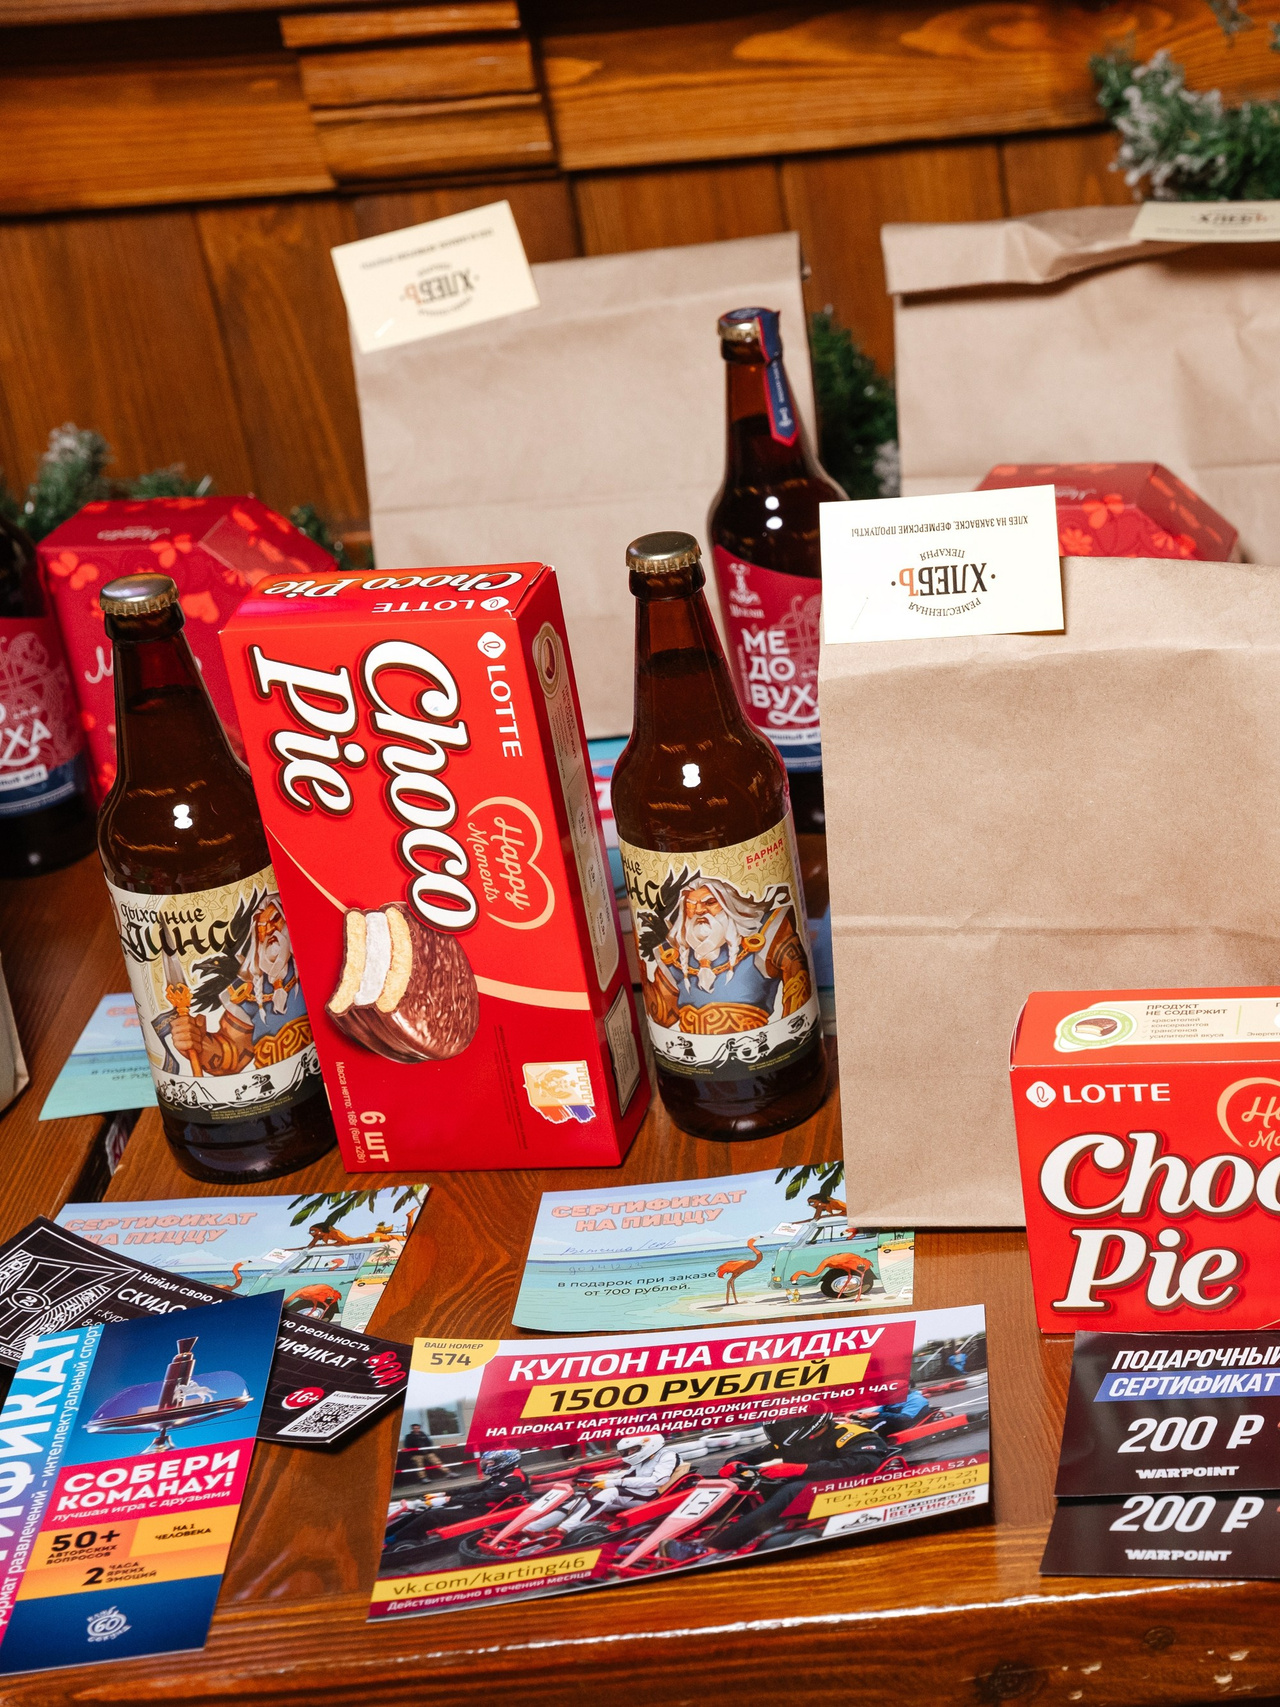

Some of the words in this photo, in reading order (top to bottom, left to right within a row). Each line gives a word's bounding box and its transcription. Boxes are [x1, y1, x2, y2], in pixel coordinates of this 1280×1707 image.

[898, 521, 952, 534] ФЕРМЕРСКИЕ
[996, 517, 1006, 526] НА
[1008, 515, 1028, 525] ХЛЕБ
[851, 525, 896, 538] ПРОДУКТЫ
[919, 548, 966, 561] ПЕКАРНЯ
[264, 577, 356, 598] Pie
[360, 570, 523, 592] Choco
[899, 562, 988, 597] ХЛЕБЪ
[372, 600, 475, 614] LOTTE
[908, 598, 982, 617] РЕМЕСЛЕННАЯ
[486, 664, 524, 758] LOTTE
[248, 644, 367, 817] Pie
[359, 638, 480, 932] Choco
[746, 837, 784, 865] БАРНАЯ
[466, 822, 494, 904] Moments
[490, 816, 530, 912] Happy
[1164, 1008, 1228, 1016] СОДЕРЖИТ
[336, 1062, 347, 1085] Масса
[1063, 1082, 1170, 1104] LOTTE
[360, 1110, 386, 1124] 6
[552, 1190, 747, 1218] СЕРТИФИКАТ
[64, 1212, 258, 1232] СЕРТИФИКАТ
[575, 1219, 617, 1232] НА
[621, 1208, 724, 1230] ПИЦЦУ
[123, 1228, 228, 1246] ПИЦЦУ
[570, 1279, 633, 1289] подарок
[636, 1276, 665, 1285] при
[668, 1272, 716, 1282] заказе
[1050, 1226, 1243, 1313] Pie
[634, 1284, 691, 1296] рублей.
[138, 1272, 177, 1292] Найди
[179, 1287, 213, 1304] свою
[296, 1325, 370, 1352] реальность
[424, 1341, 448, 1349] ВАШ
[508, 1351, 650, 1381] КУПОН
[656, 1347, 712, 1370] НА
[722, 1327, 886, 1364] СКИДКУ
[430, 1353, 471, 1366] 574
[549, 1383, 649, 1412] 1500
[659, 1358, 830, 1402] РУБЛЕЙ
[1108, 1373, 1280, 1397] СЕРТИФИКАТ
[289, 1390, 320, 1403] 16+
[485, 1426, 507, 1437] НА
[510, 1421, 574, 1435] ПРОКАТ
[576, 1412, 659, 1429] КАРТИНГА
[661, 1388, 855, 1420] ПРОДОЛЖИТЕЛЬНОСТЬЮ
[858, 1387, 865, 1395] 1
[868, 1382, 898, 1393] ЧАС
[577, 1430, 612, 1442] ДЛЯ
[615, 1418, 698, 1437] КОМАНДЫ
[701, 1416, 724, 1426] ОТ
[726, 1415, 734, 1423] 6
[742, 1406, 808, 1420] ЧЕЛОВЕК
[1117, 1416, 1218, 1453] 200
[14, 1488, 48, 1574] развлечений
[42, 1361, 88, 1478] интеллектуальный
[64, 1450, 241, 1494] СОБЕРИ
[811, 1484, 835, 1494] 1-Я
[948, 1460, 966, 1469] 52
[1135, 1466, 1240, 1479] WARPOINT
[56, 1471, 236, 1512] КОМАНДУ!
[863, 1489, 879, 1497] +7
[881, 1481, 922, 1494] (4712)
[864, 1493, 901, 1506] (920)
[52, 1507, 108, 1522] лучшая
[111, 1502, 146, 1516] игра
[160, 1490, 231, 1508] друзьями
[890, 1496, 975, 1518] ВЕРТИКАЛЬ
[1109, 1495, 1216, 1532] 200
[51, 1529, 120, 1552] 50+
[155, 1528, 212, 1540] ЧЕЛОВЕКА
[46, 1552, 111, 1565] ВОПРОСОВ
[48, 1544, 118, 1559] АВТОРСКИХ
[1125, 1549, 1232, 1561] WARPOINT
[82, 1566, 105, 1586] 2
[106, 1566, 145, 1576] ЯРКИХ
[106, 1570, 157, 1583] ЭМОЦИЙ
[108, 1562, 140, 1570] ЧАСА
[393, 1556, 585, 1595] vk.com/karting46
[387, 1590, 481, 1612] Действительно
[495, 1580, 544, 1593] течении
[547, 1571, 591, 1585] месяца
